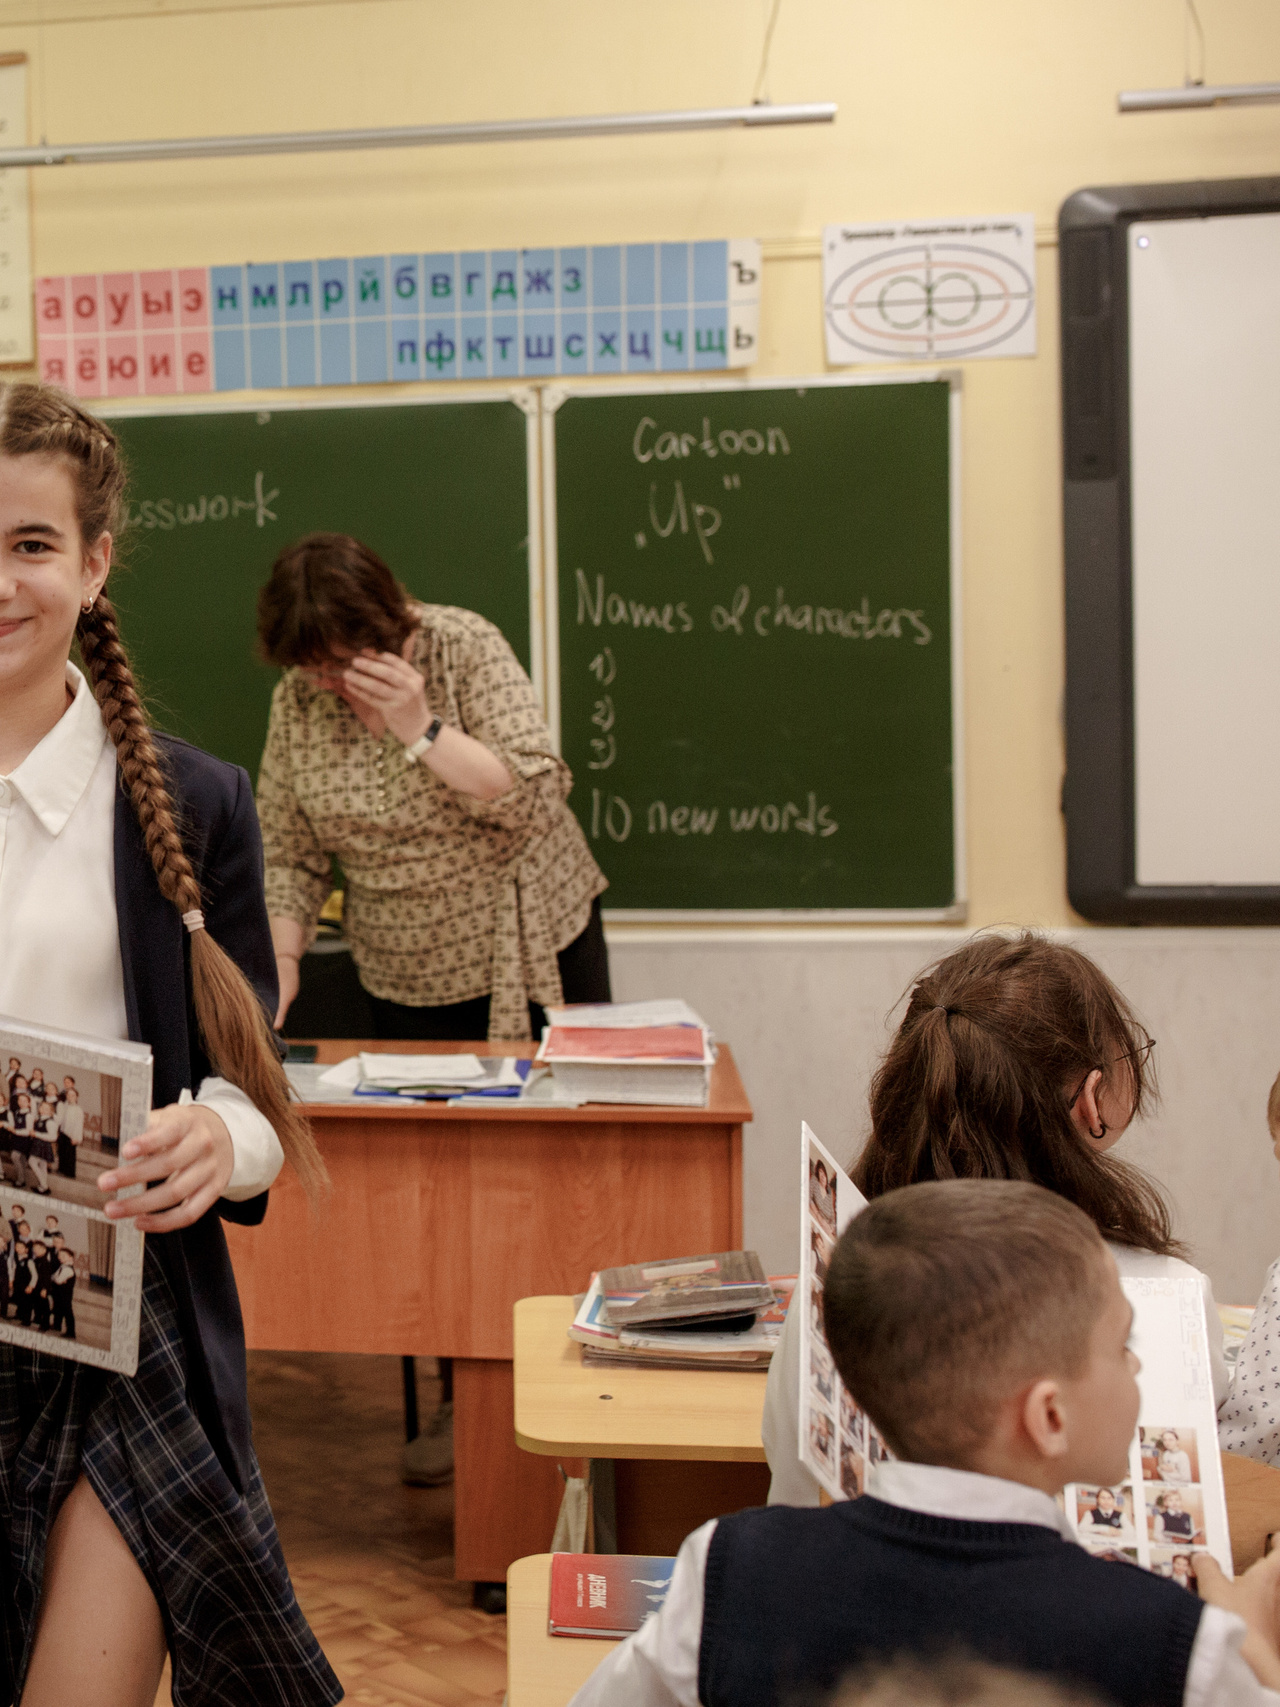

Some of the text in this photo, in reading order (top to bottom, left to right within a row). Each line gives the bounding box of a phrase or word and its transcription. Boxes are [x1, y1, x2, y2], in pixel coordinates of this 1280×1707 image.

[633, 416, 791, 463] Cartoon
[122, 471, 280, 530] sswork
[576, 568, 933, 646] Names of characters
[591, 788, 839, 843] 10 new words
[587, 1573, 607, 1609] ДНЕВНИК
